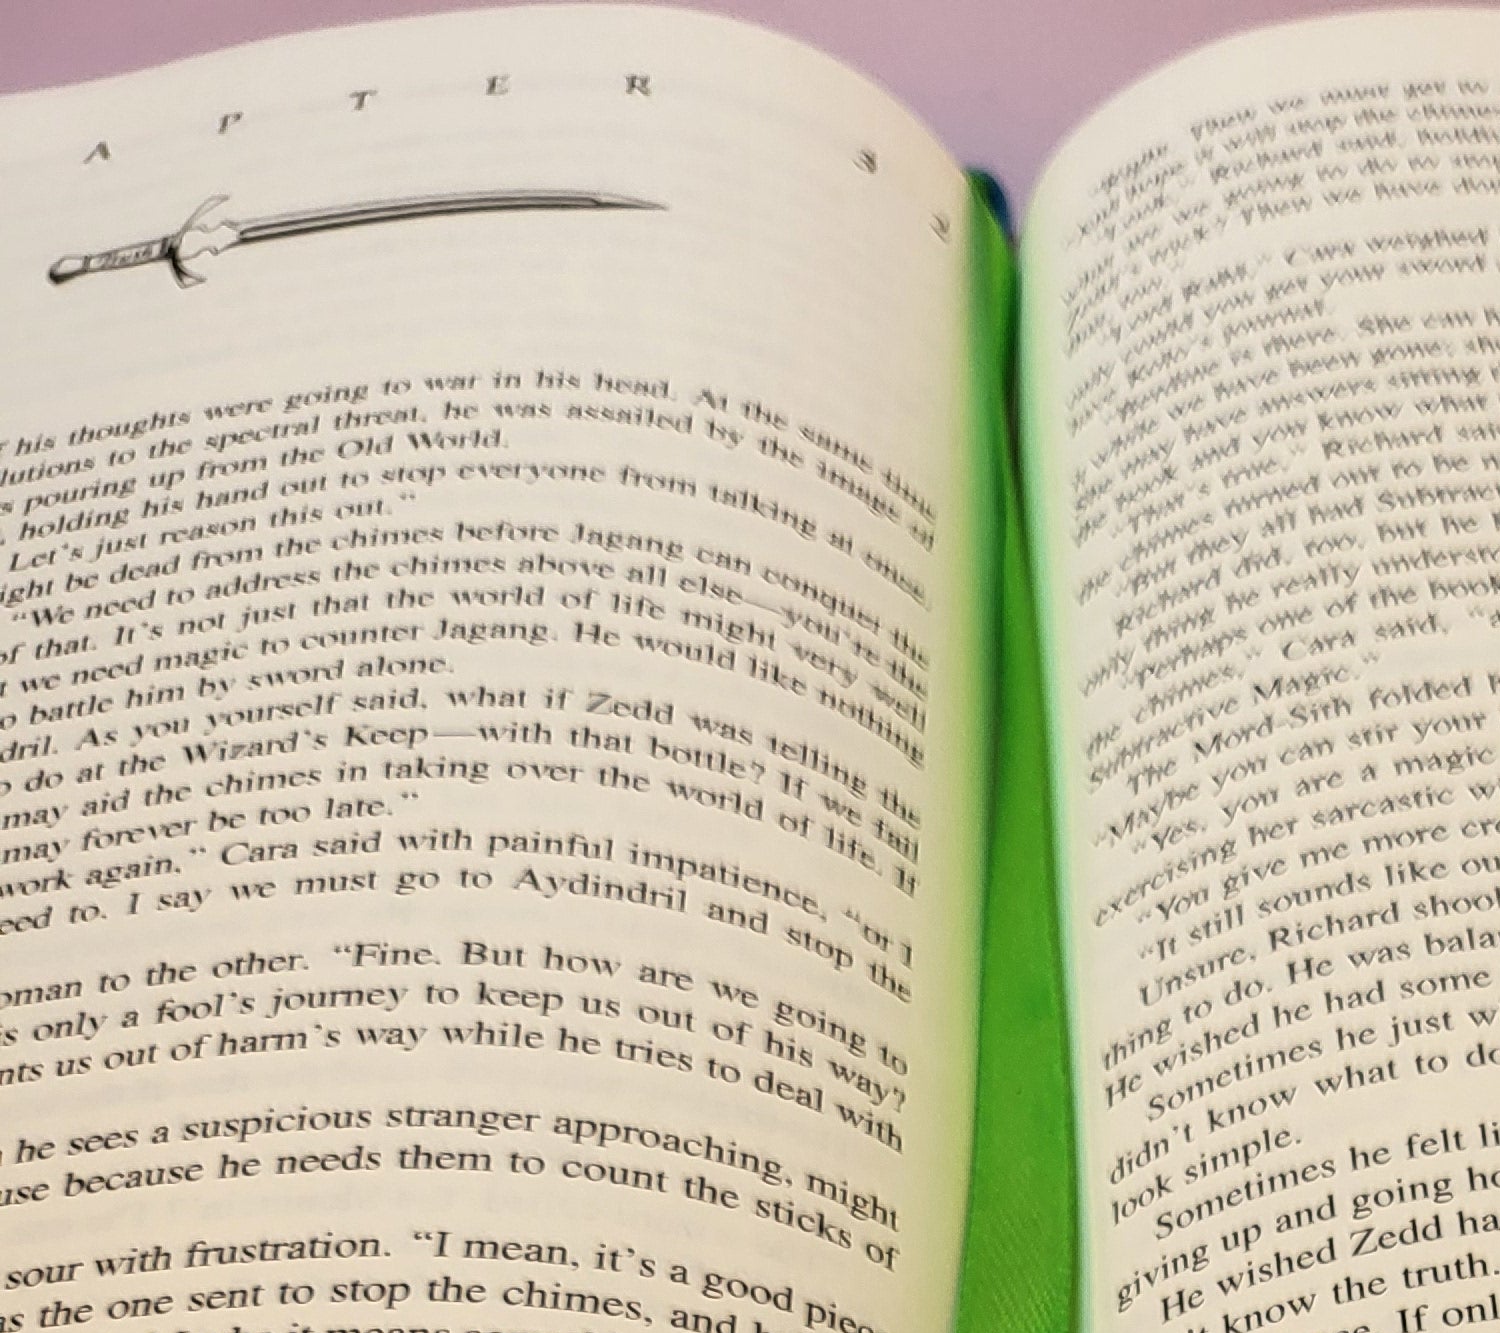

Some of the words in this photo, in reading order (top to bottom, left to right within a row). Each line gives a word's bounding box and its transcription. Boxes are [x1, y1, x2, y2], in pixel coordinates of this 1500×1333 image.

[94, 533, 148, 561] just
[158, 517, 258, 547] reason
[268, 506, 324, 529] this
[1125, 758, 1178, 797] The
[1367, 674, 1473, 712] folded
[1221, 857, 1287, 902] give
[1298, 841, 1350, 869] me
[1360, 824, 1449, 855] more
[1110, 1174, 1173, 1227] look
[1183, 1128, 1303, 1181] simple.
[1154, 1158, 1337, 1242] Sometimes
[1347, 1145, 1391, 1172] he
[1405, 1127, 1465, 1160] felt
[3, 1261, 85, 1291] sour
[92, 1244, 173, 1278] with
[183, 1231, 392, 1269] frustration.
[411, 1230, 451, 1258] “I
[462, 1239, 581, 1269] mean,
[594, 1242, 657, 1279] it’s
[667, 1264, 690, 1286] a
[700, 1272, 795, 1314] good
